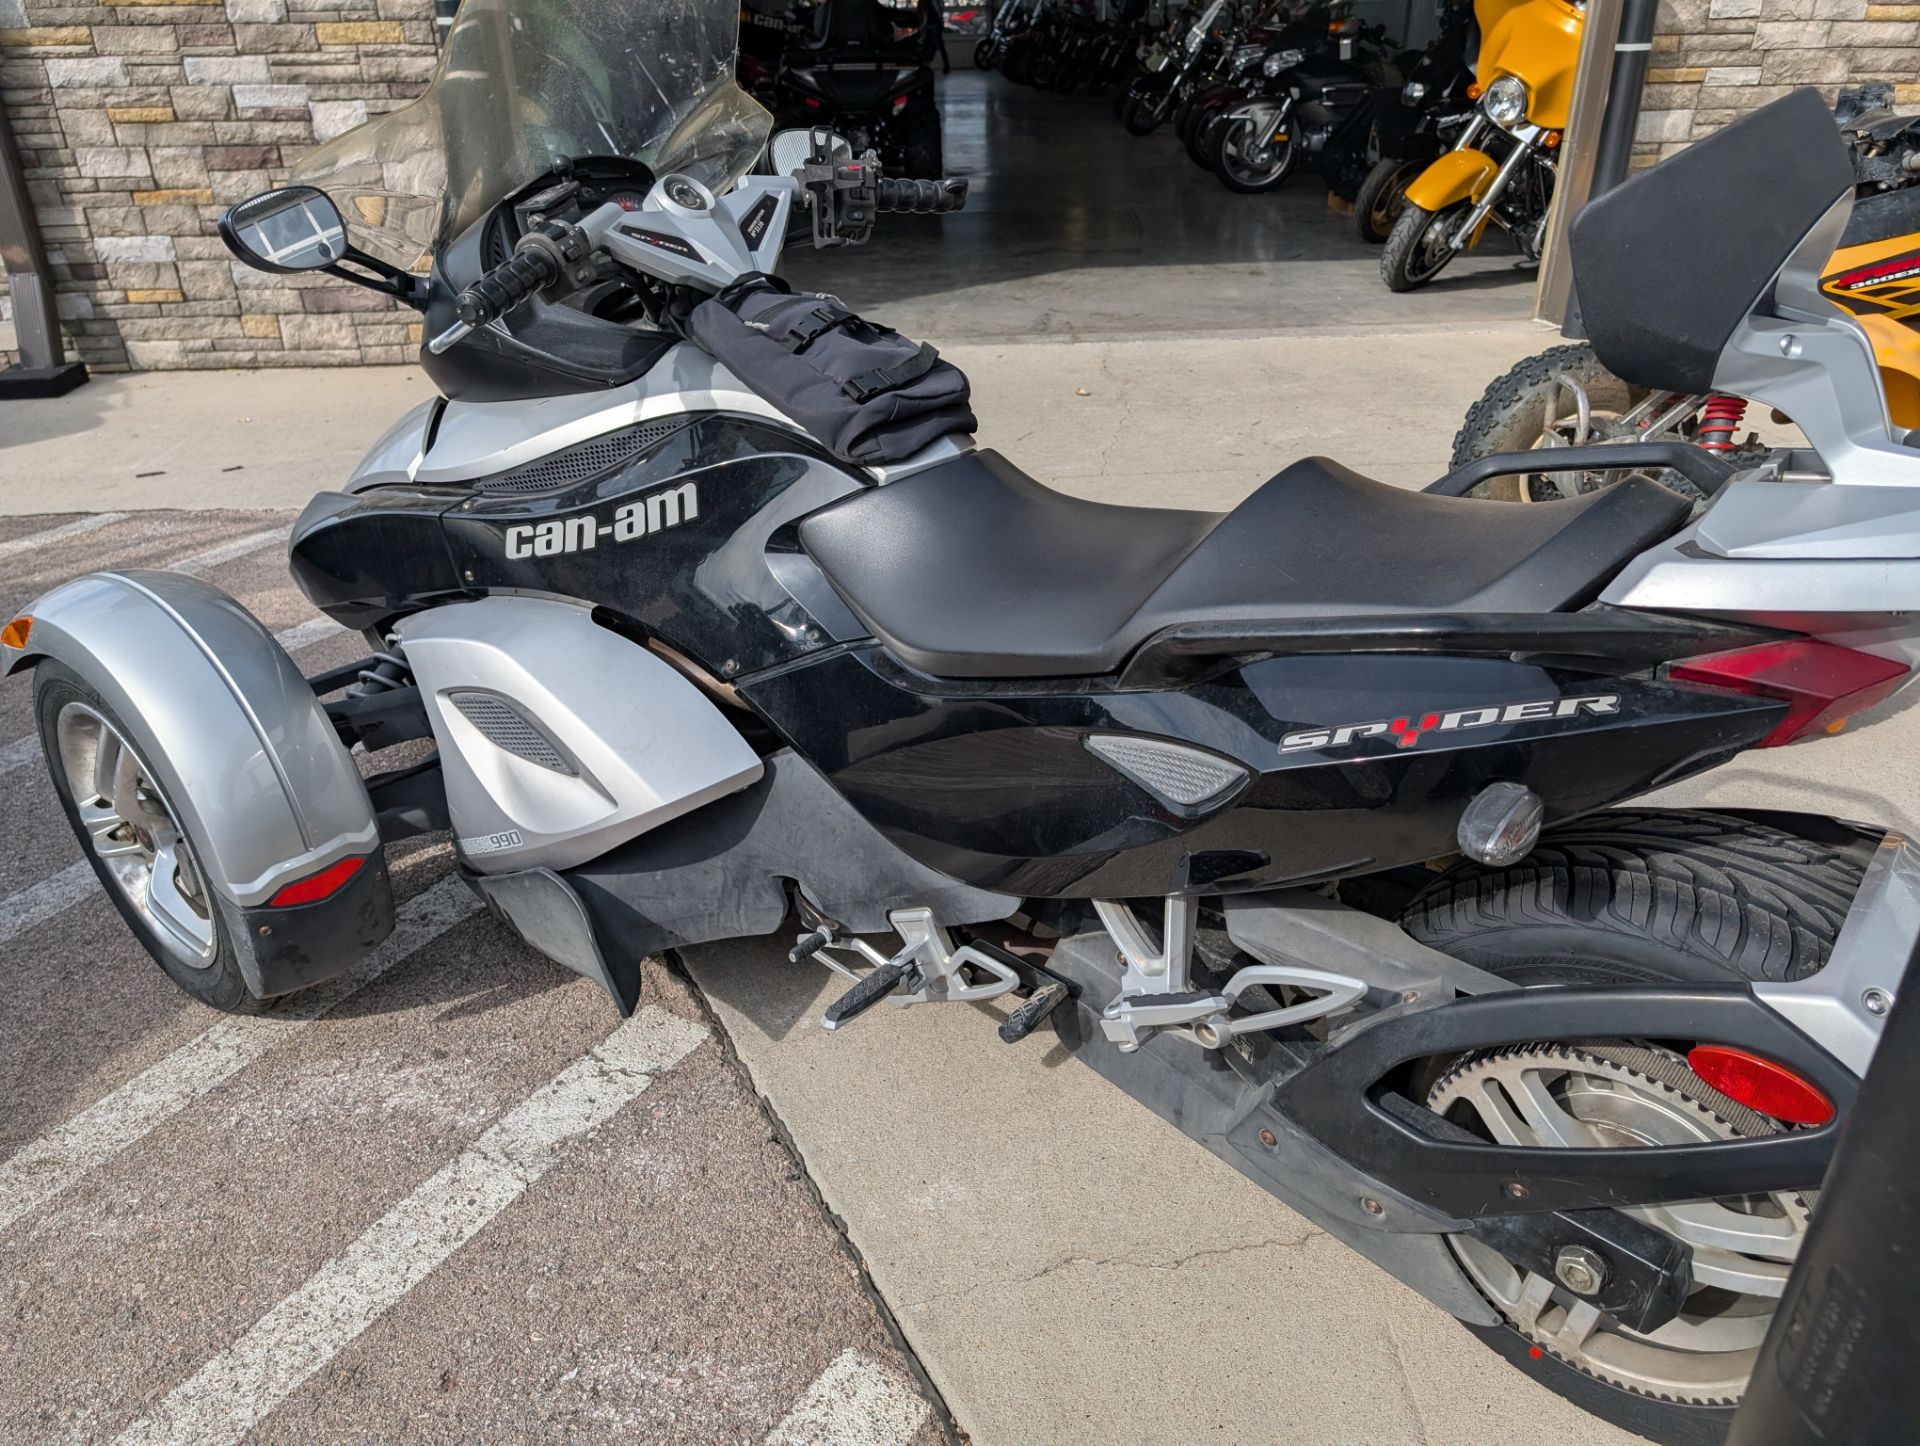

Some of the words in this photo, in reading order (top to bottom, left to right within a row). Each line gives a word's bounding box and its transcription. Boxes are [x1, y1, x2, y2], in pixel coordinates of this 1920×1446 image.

[506, 482, 698, 559] can-am
[1279, 694, 1621, 753] SPYDER
[489, 830, 522, 849] 990
